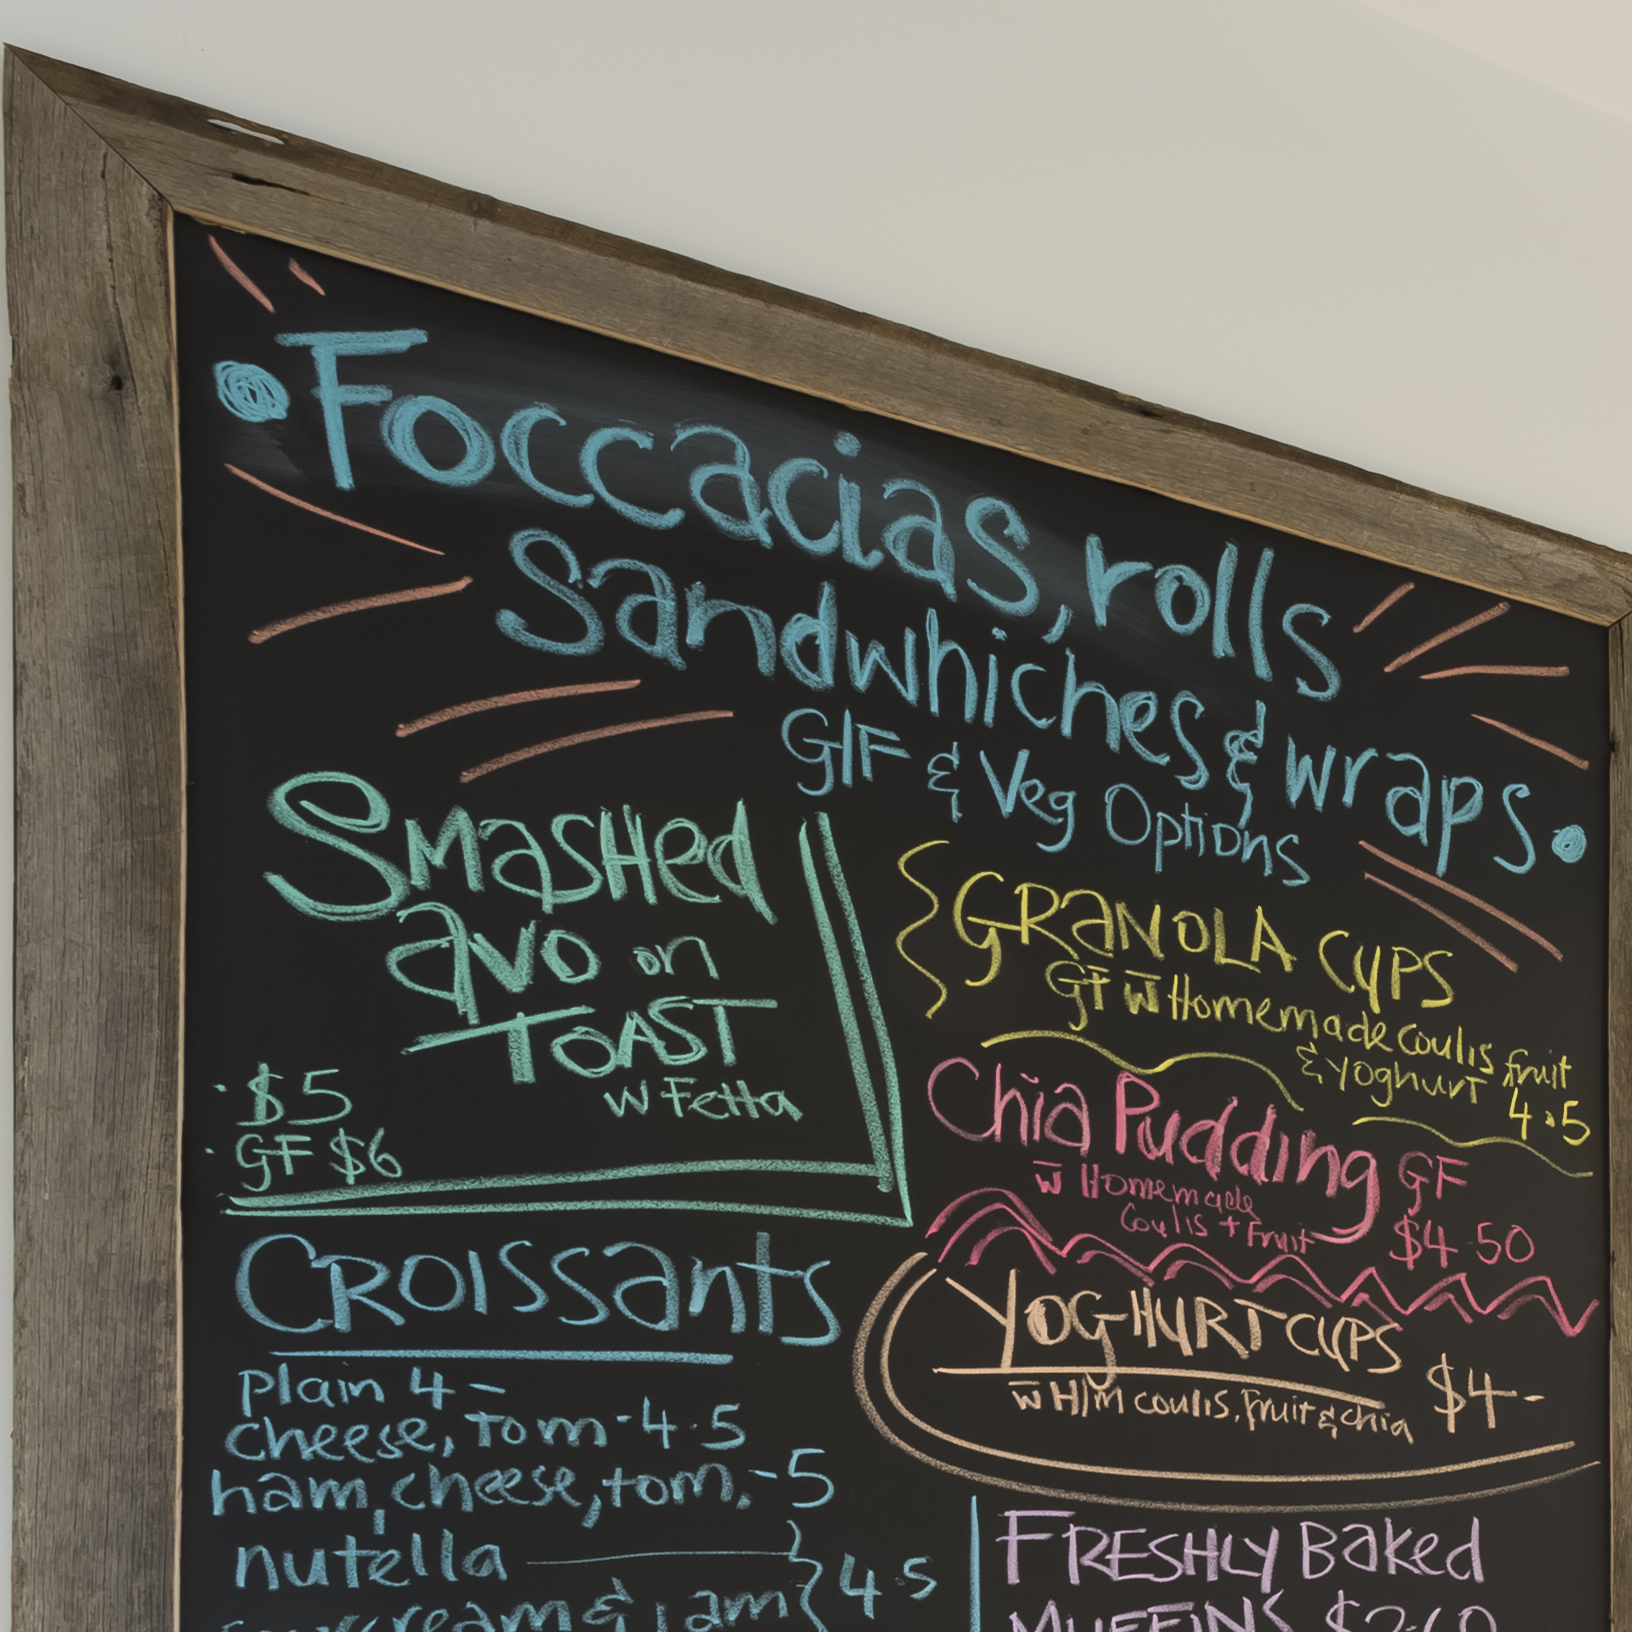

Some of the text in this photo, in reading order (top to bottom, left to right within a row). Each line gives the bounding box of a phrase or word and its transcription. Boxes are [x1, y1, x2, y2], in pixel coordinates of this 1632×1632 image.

[1087, 534, 1340, 701] rolls
[980, 748, 1075, 851] Veg
[1106, 784, 1311, 887] Options
[632, 935, 721, 980] on
[1165, 974, 1392, 1054] Homemade
[235, 1062, 354, 1126] $5
[328, 1126, 403, 1187] $6
[927, 1056, 1091, 1148] Chia
[1399, 1152, 1470, 1216] GF
[1285, 1311, 1405, 1373] CUPS
[236, 1530, 508, 1589] nutella
[996, 1510, 1281, 1593] FRESHLY
